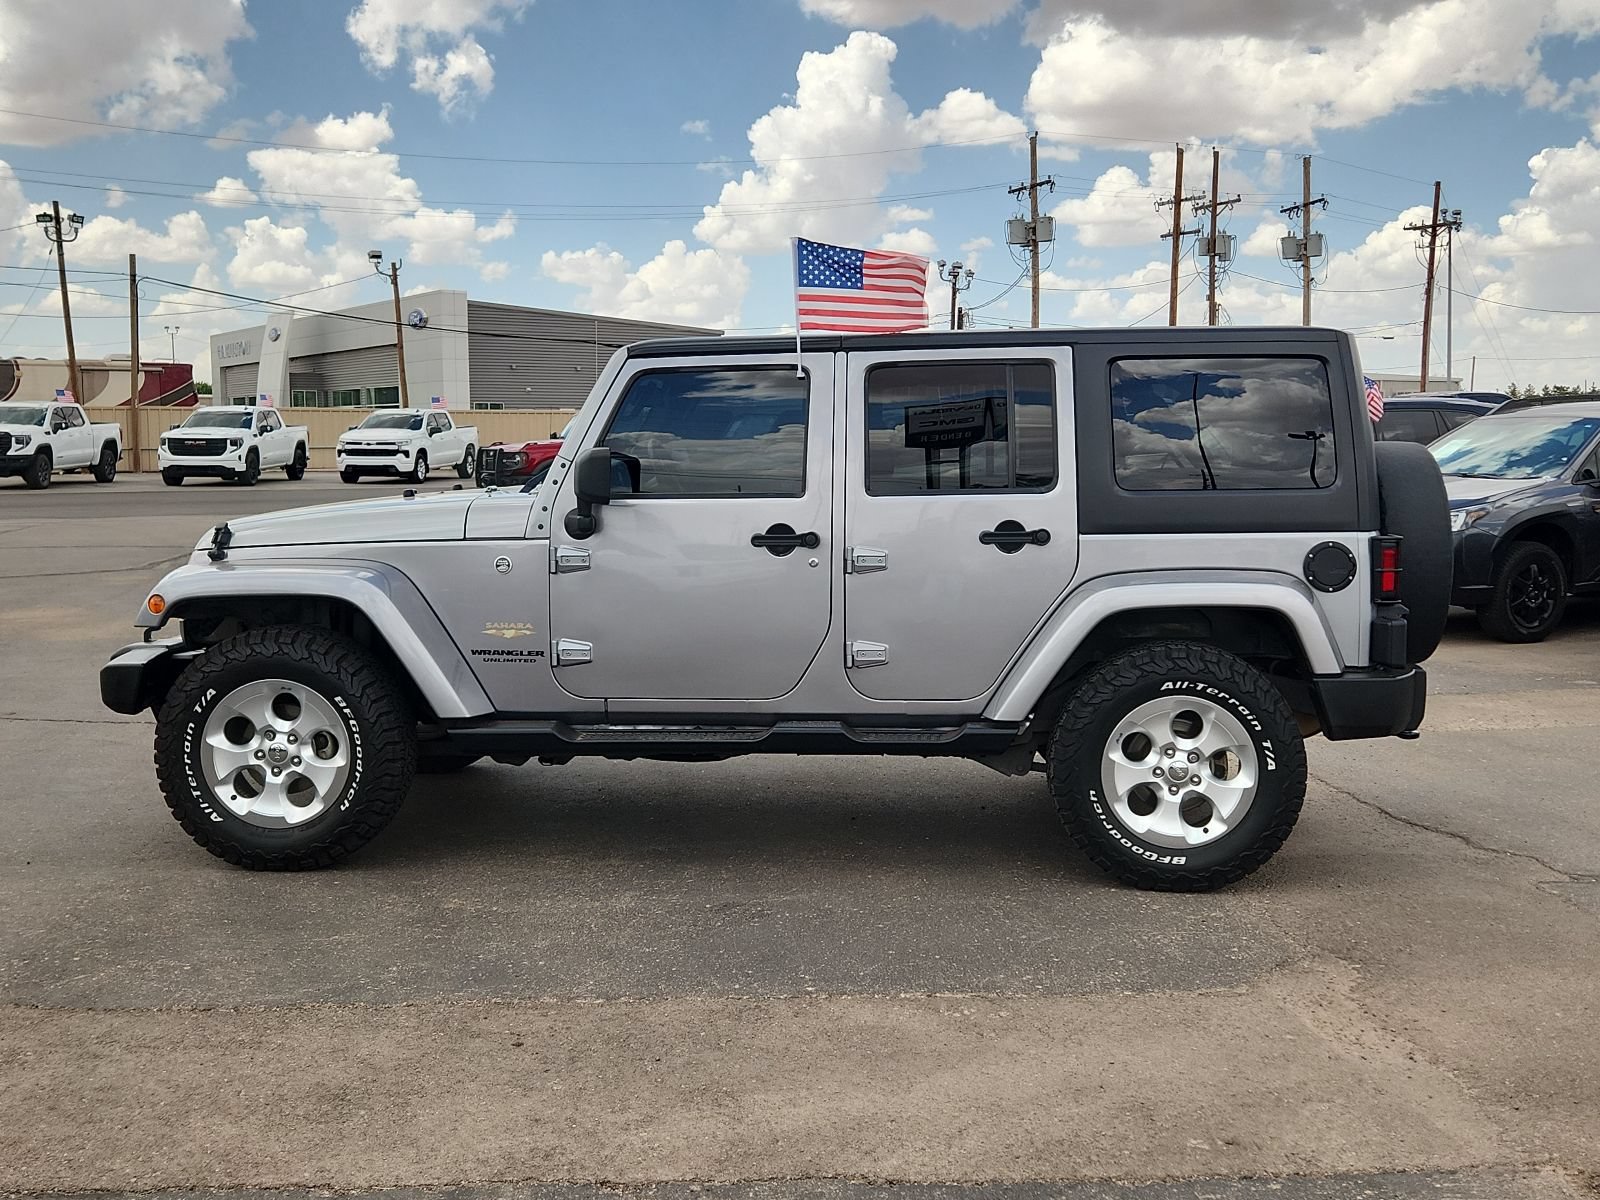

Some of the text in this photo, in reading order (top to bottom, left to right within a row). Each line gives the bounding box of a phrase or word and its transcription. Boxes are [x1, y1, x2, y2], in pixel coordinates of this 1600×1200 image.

[471, 649, 545, 657] WRANGLER
[183, 688, 224, 822] All-Terrain T/A
[334, 696, 364, 812] BFGoodrich
[1160, 681, 1276, 771] All-Terrain T/A
[1089, 790, 1187, 865] BFGoodrich
